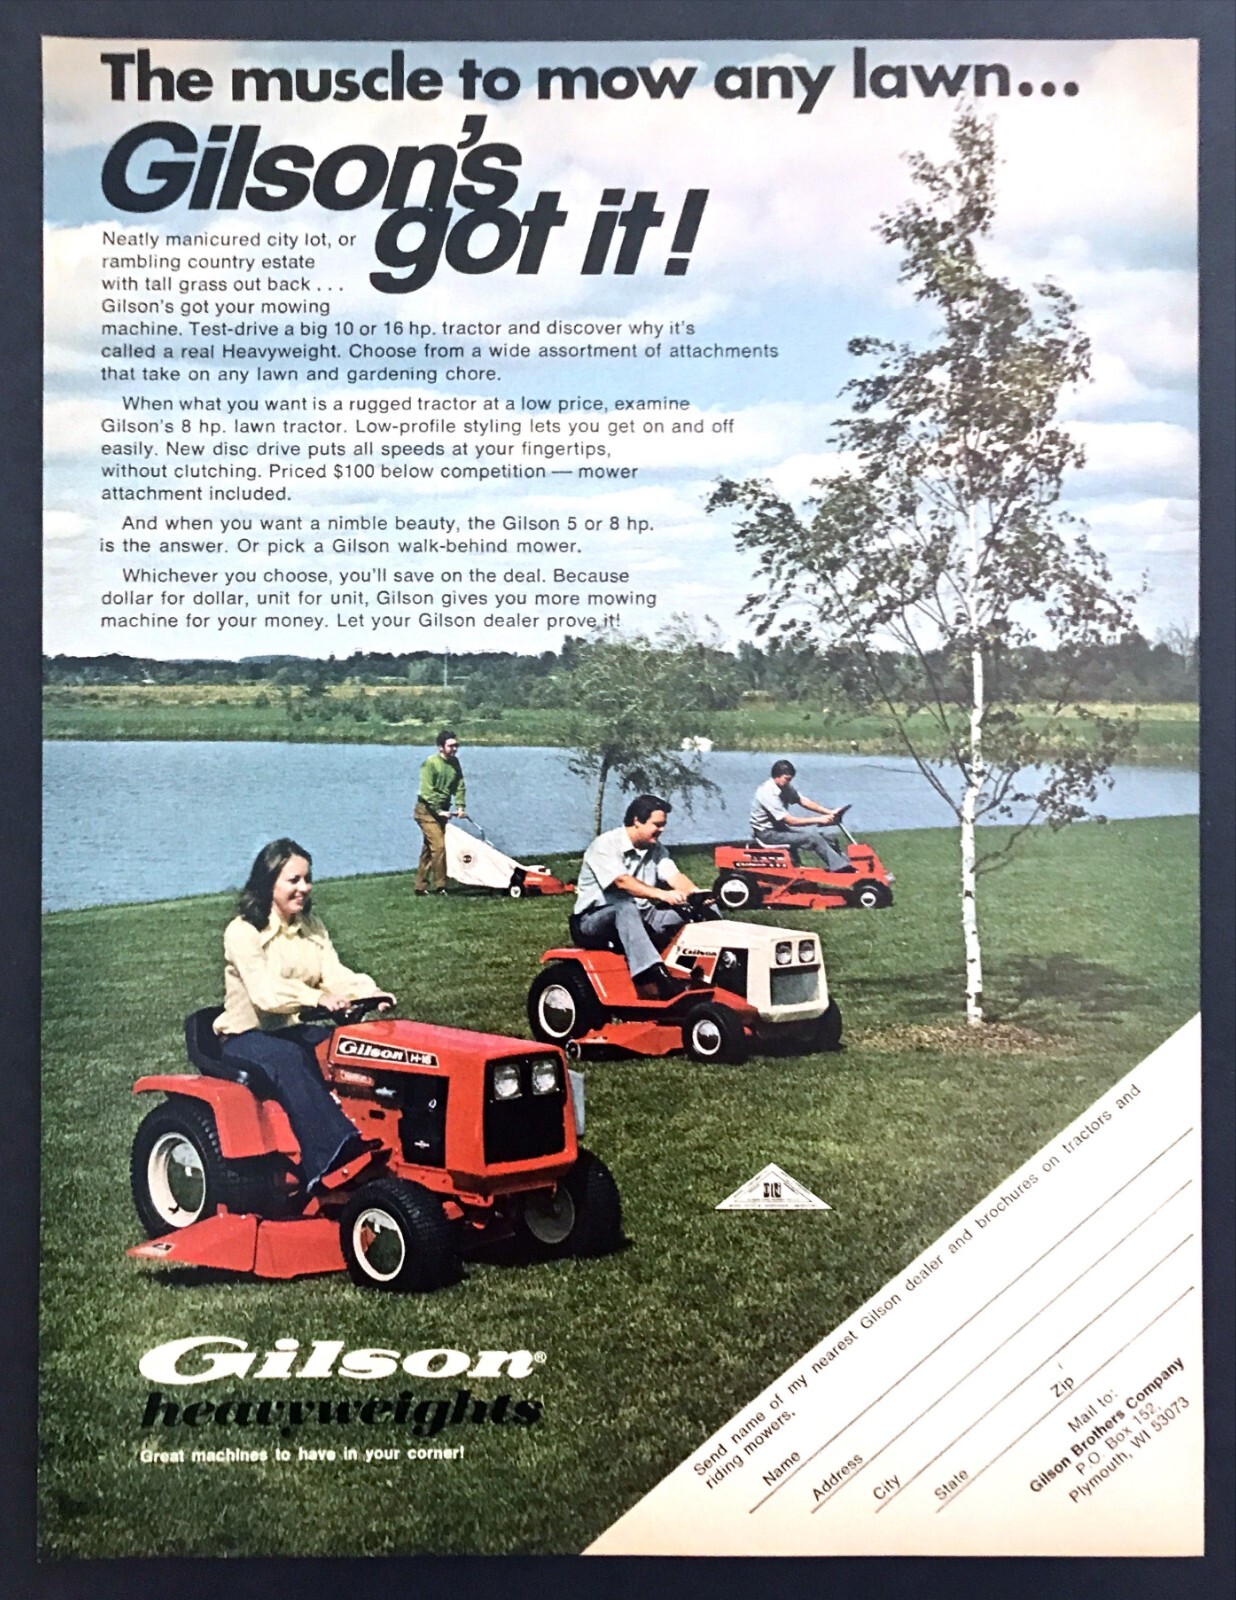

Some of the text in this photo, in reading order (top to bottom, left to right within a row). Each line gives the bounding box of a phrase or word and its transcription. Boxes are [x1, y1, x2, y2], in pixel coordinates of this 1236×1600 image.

[101, 49, 213, 101] The
[232, 50, 443, 102] muscle
[459, 60, 520, 100] to
[538, 67, 697, 99] mow
[715, 66, 835, 113] any
[101, 113, 522, 212] Gilson's
[102, 231, 356, 250] Neatly manicured city lot, or
[370, 189, 709, 294] got it!
[101, 254, 315, 272] rambling country estate
[101, 276, 310, 294] with tall grass out back
[101, 298, 330, 317] Gilson's got your mowing
[101, 320, 695, 339] machine. Test-drive a big 10 or 16 hp. tractor and discover why it's
[100, 343, 778, 362] called a real Heavyweight. Choose from a wide assortment of attachments
[100, 366, 501, 384] that take on any lawn and gardening chore.
[121, 396, 690, 414] When what you want is a rugged tractor at a low price, examine
[100, 441, 610, 459] easily. New disc drive puts all speeds at your fingertips,
[100, 486, 291, 501] attachment included.
[121, 516, 653, 534] And when you want a nimble beauty, the Gilson 5 or 8 hp.
[122, 568, 629, 586] Whichever you choose, you'll save on the deal. Because
[100, 613, 620, 632] machine for your money. Let your Gilson dealer prove it!
[339, 1041, 404, 1061] Gilson
[694, 1083, 1141, 1477] Send name of my nearest Gilson dealer and brochures on tractors and
[141, 1390, 544, 1437] heavyweights
[1067, 1389, 1119, 1432] Mail to:
[1029, 1357, 1185, 1493] Gilson Brothers Company
[934, 1376, 1074, 1501] State Zip
[1105, 1425, 1133, 1451] Box
[140, 1445, 465, 1466] Great machines to have in your corner!
[1068, 1396, 1190, 1504] Plymouth, WI 53073
[706, 1455, 744, 1489] riding
[762, 1451, 801, 1486] Name
[812, 1452, 864, 1502] Address
[873, 1475, 901, 1500] City
